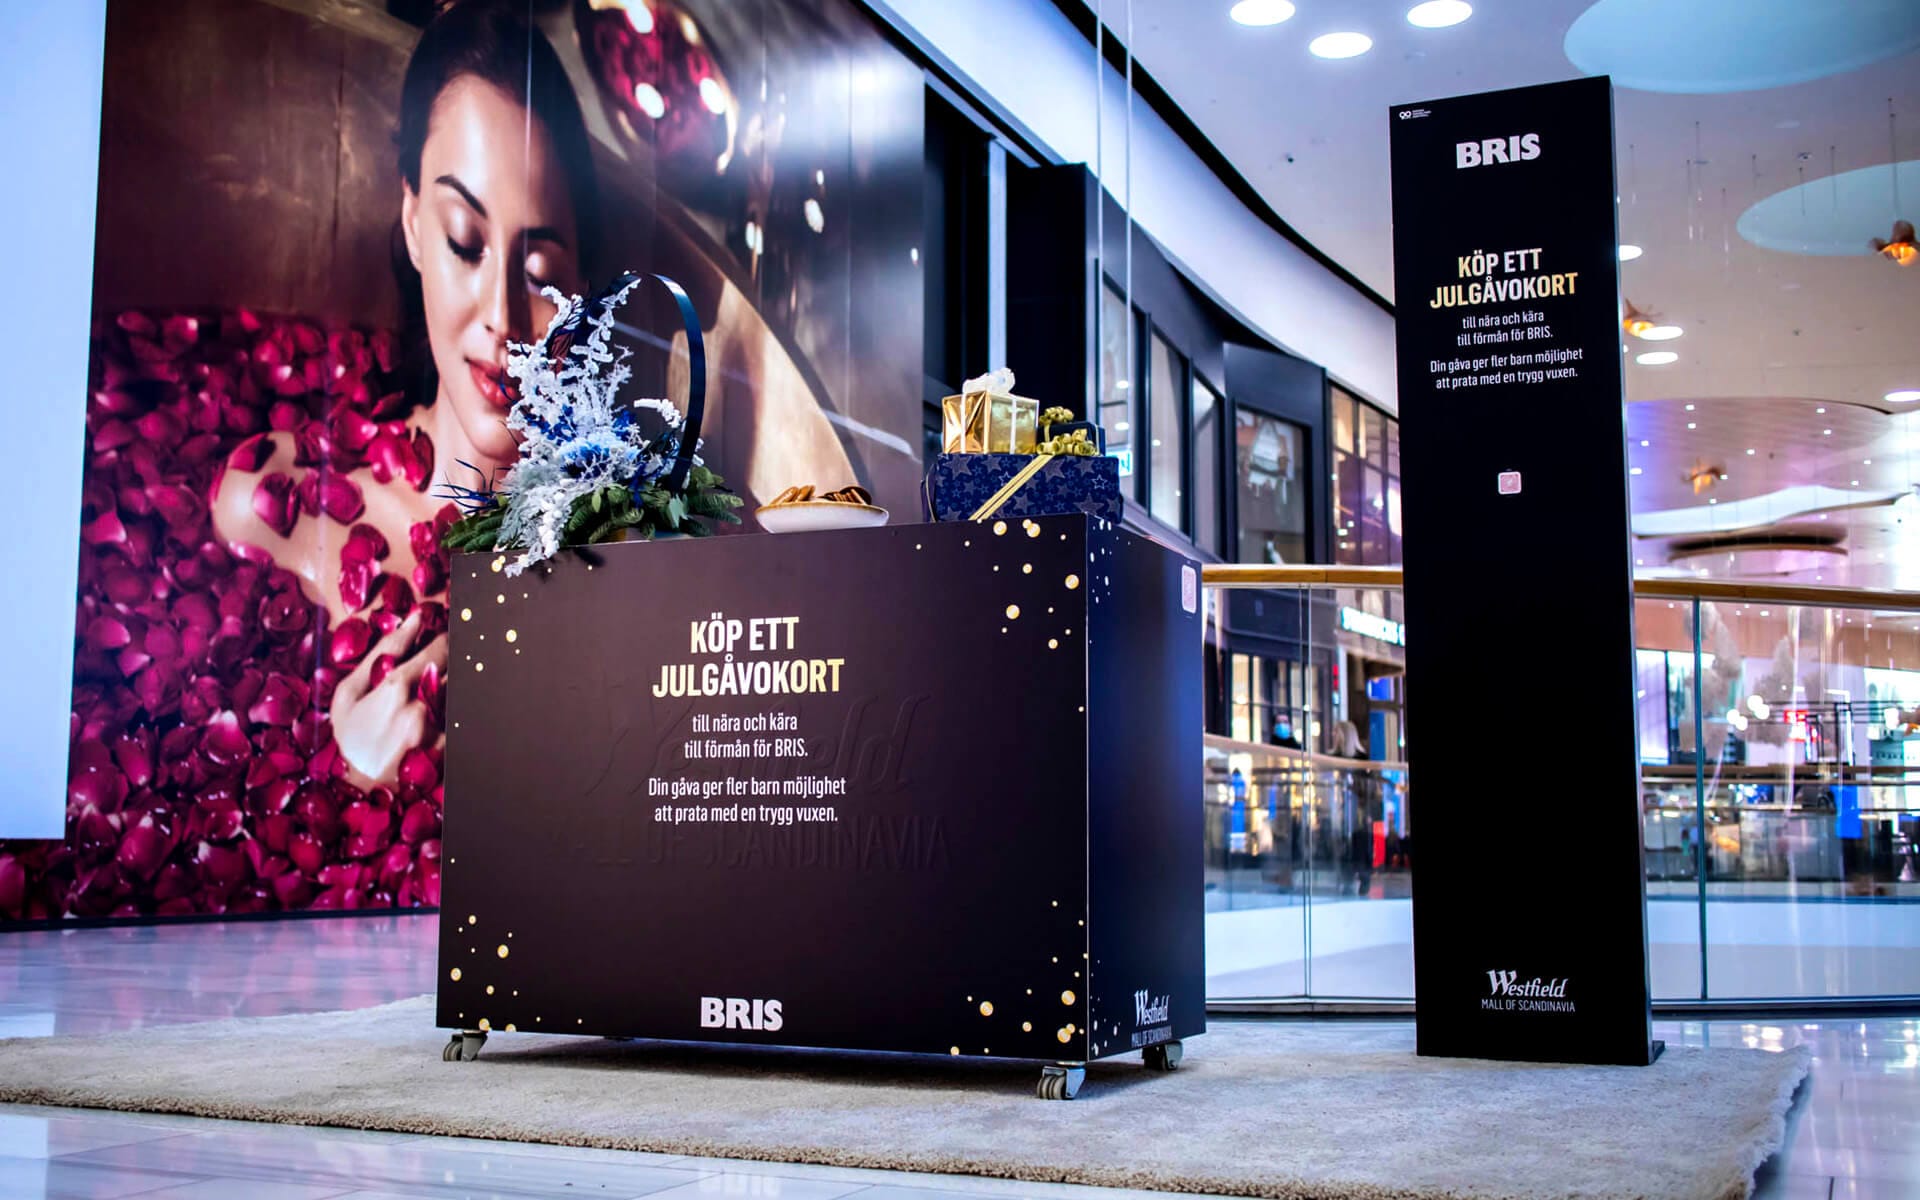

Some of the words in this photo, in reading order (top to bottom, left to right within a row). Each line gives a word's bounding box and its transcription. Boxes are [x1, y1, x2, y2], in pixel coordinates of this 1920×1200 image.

[1456, 133, 1541, 169] BRIS
[1458, 249, 1499, 278] KÖP
[1504, 248, 1542, 273] ETT
[1430, 272, 1578, 308] JULGÅVOKORT
[1462, 316, 1476, 329] till
[1478, 315, 1500, 327] nära
[1502, 312, 1520, 325] och
[1522, 310, 1544, 323] kära
[1457, 333, 1471, 346] till
[1473, 330, 1508, 344] förmån
[1511, 329, 1525, 341] för
[1527, 325, 1553, 340] BRIS.
[1430, 360, 1446, 373] Din
[1448, 358, 1471, 374] gåva
[1473, 358, 1489, 371] ger
[1491, 355, 1508, 367] fler
[1510, 353, 1533, 365] barn
[1535, 348, 1583, 364] möjlighet
[1436, 377, 1450, 389] att
[1452, 375, 1478, 390] prata
[1480, 372, 1501, 385] med
[1503, 373, 1515, 383] en
[1517, 370, 1544, 384] trygg
[1546, 368, 1578, 379] vuxen.
[691, 612, 743, 653] KÖP
[749, 616, 799, 651] ETT
[652, 653, 845, 698] JULGÅVOKORT
[692, 714, 710, 732] till
[713, 714, 740, 732] nära
[743, 713, 766, 731] och
[770, 712, 797, 731] kära
[684, 740, 702, 758] till
[705, 739, 750, 758] förmån
[753, 739, 772, 757] för
[775, 738, 808, 757] BRIS.
[649, 777, 668, 796] Din
[671, 777, 700, 799] gåva
[703, 781, 723, 799] ger
[726, 777, 748, 795] fler
[751, 777, 780, 795] barn
[783, 776, 846, 799] möjlighet
[655, 805, 672, 822] att
[675, 805, 708, 825] prata
[711, 803, 738, 822] med
[741, 807, 756, 822] en
[759, 805, 793, 825] trygg
[796, 807, 838, 822] vuxen.
[1486, 969, 1569, 998] Westfield
[701, 997, 783, 1031] BRIS
[1481, 998, 1504, 1010] MALL
[1505, 999, 1517, 1010] OF
[1518, 999, 1576, 1013] SCANDINAVIA
